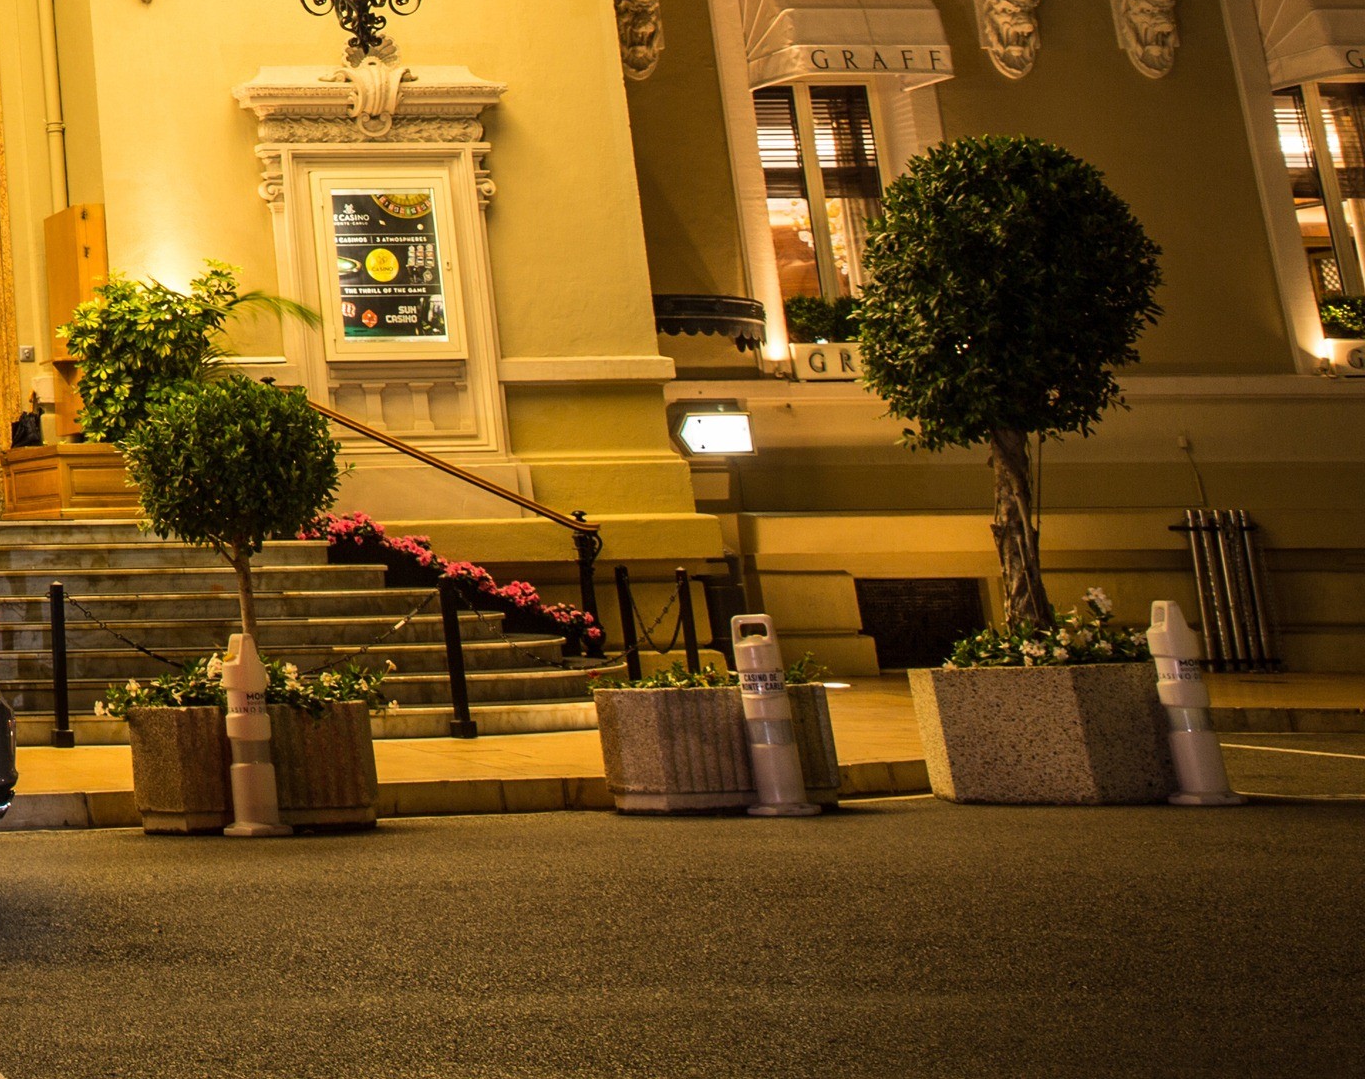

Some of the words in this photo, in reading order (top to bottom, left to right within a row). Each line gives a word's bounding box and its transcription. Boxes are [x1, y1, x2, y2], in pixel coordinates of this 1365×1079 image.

[810, 49, 942, 70] GRAFF
[338, 213, 370, 221] CASINO
[398, 305, 417, 314] SUN
[385, 314, 418, 323] CASINO
[743, 673, 767, 682] CASINO
[769, 673, 778, 681] DE
